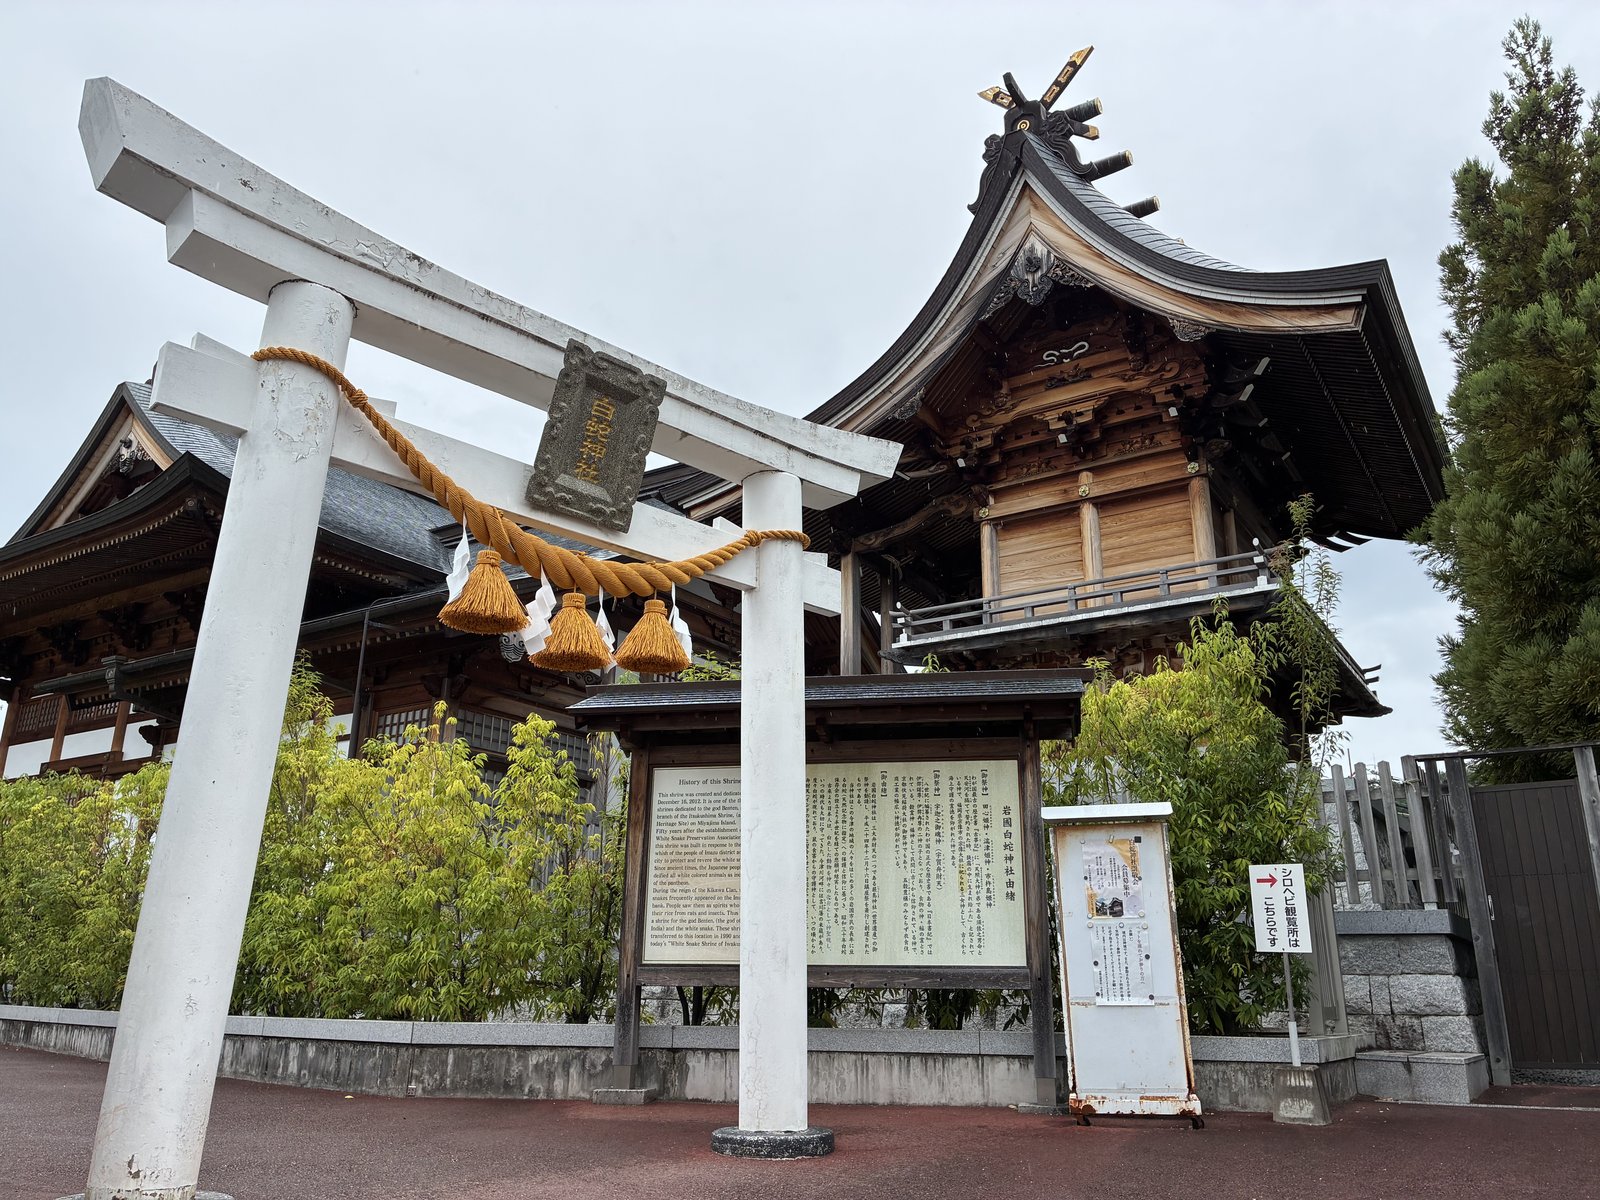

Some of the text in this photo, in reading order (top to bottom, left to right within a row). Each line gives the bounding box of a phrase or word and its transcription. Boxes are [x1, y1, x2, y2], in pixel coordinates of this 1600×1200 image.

[1002, 805, 1016, 902] 岩國白蛇神社由緒
[1264, 896, 1278, 947] こちらです
[1282, 868, 1300, 948] シロヘビ観覧所は
